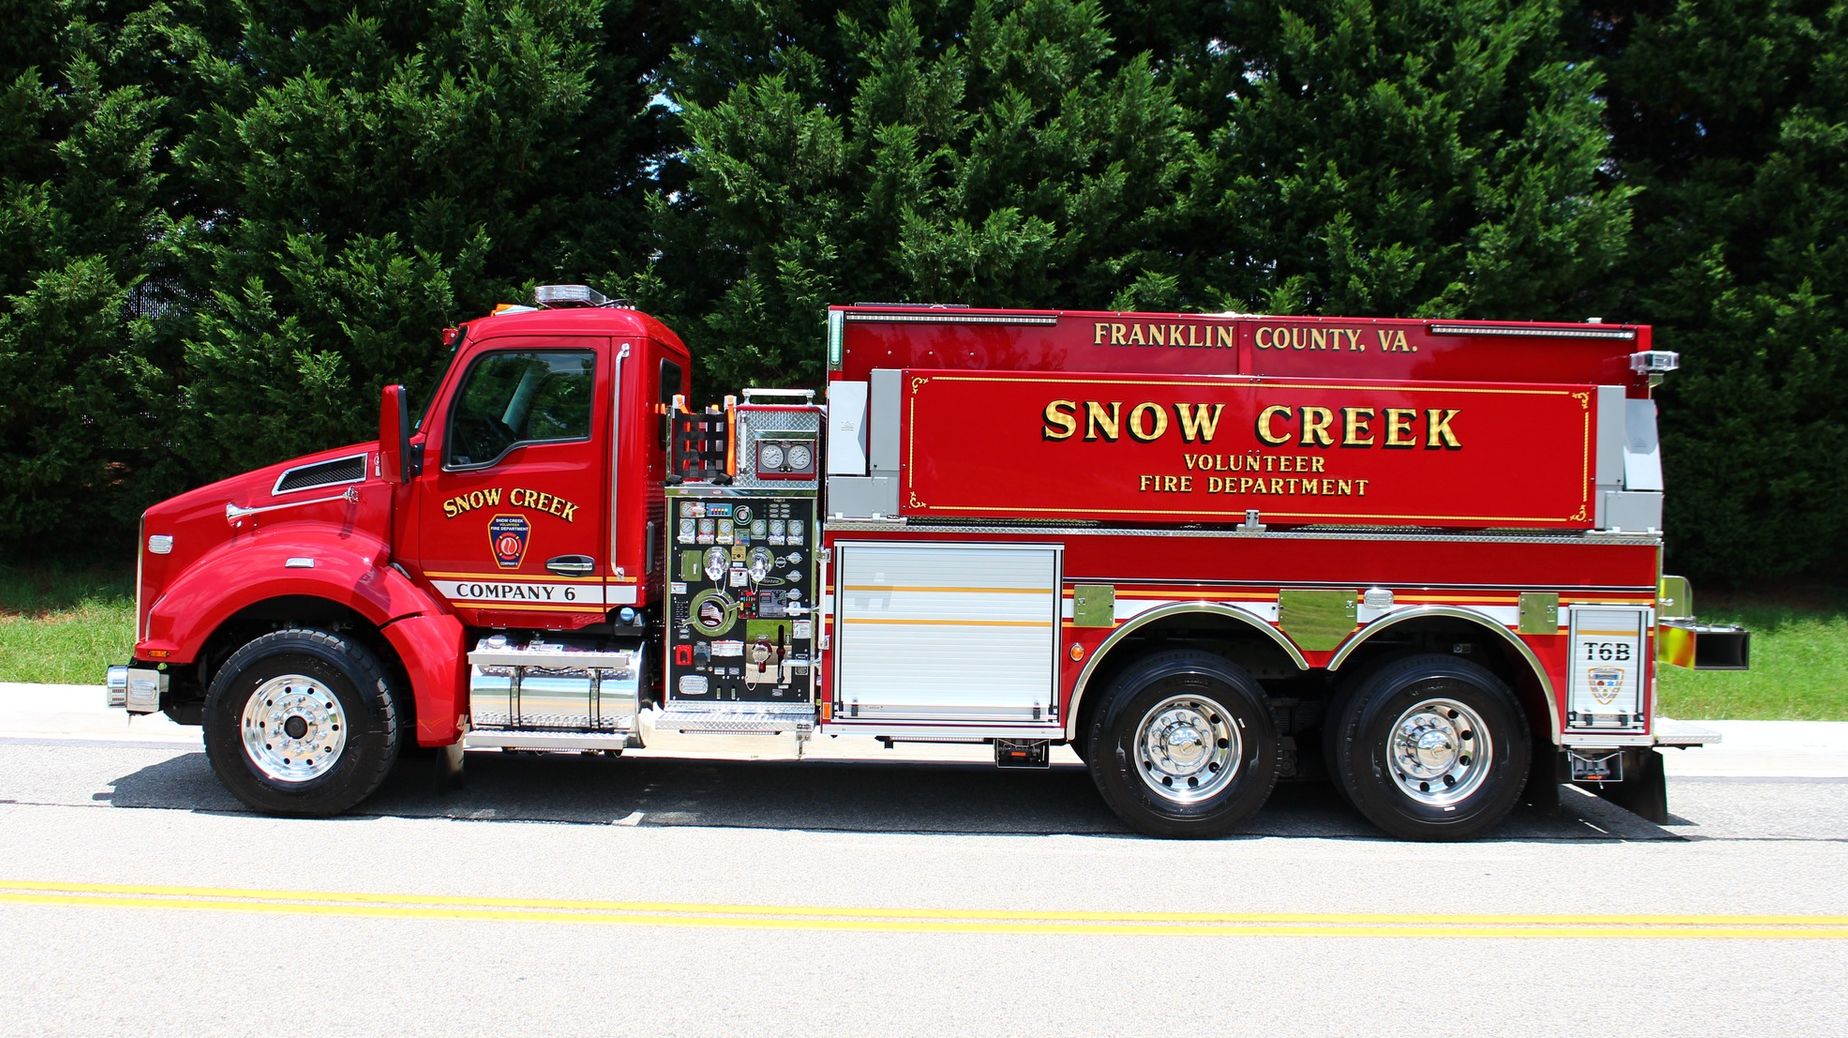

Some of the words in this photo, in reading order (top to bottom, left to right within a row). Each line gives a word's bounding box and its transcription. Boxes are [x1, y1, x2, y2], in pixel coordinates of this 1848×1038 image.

[1093, 322, 1234, 349] FRANKLIN
[1254, 326, 1366, 353] COUNTY,
[1378, 329, 1419, 353] VA.
[1042, 398, 1226, 443] SNOW
[1255, 404, 1463, 449] CREEK
[1183, 453, 1326, 474] VOLUNTEER
[1139, 474, 1193, 493] FIRE
[1207, 476, 1369, 497] DEPARTMENT
[443, 488, 502, 518] SNOW
[510, 488, 580, 522] CREEK
[456, 583, 555, 600] COMPANY
[564, 586, 576, 601] 6
[1583, 642, 1631, 661] T6B
